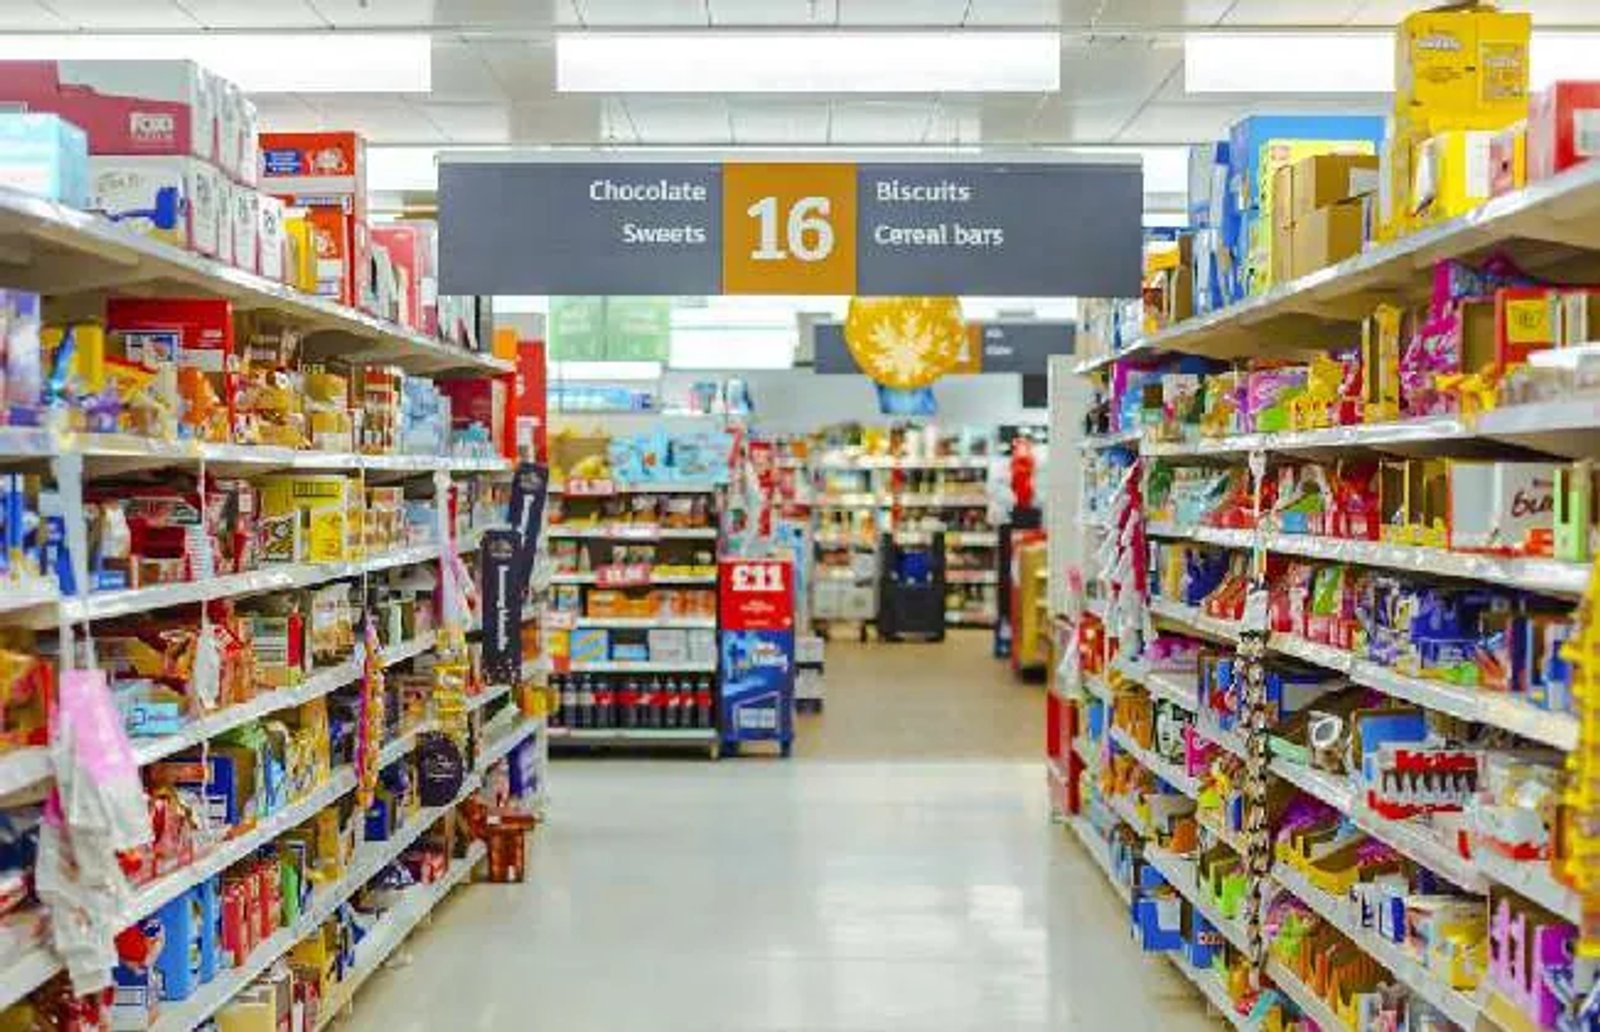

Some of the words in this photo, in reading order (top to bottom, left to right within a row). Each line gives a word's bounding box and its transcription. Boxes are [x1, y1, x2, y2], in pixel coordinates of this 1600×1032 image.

[589, 178, 707, 202] Chocolate
[876, 178, 972, 202] Biscuits
[622, 222, 707, 244] Sweets
[746, 195, 835, 263] 16
[873, 223, 948, 246] Cereal
[953, 222, 1004, 246] bars
[732, 565, 786, 592] £11
